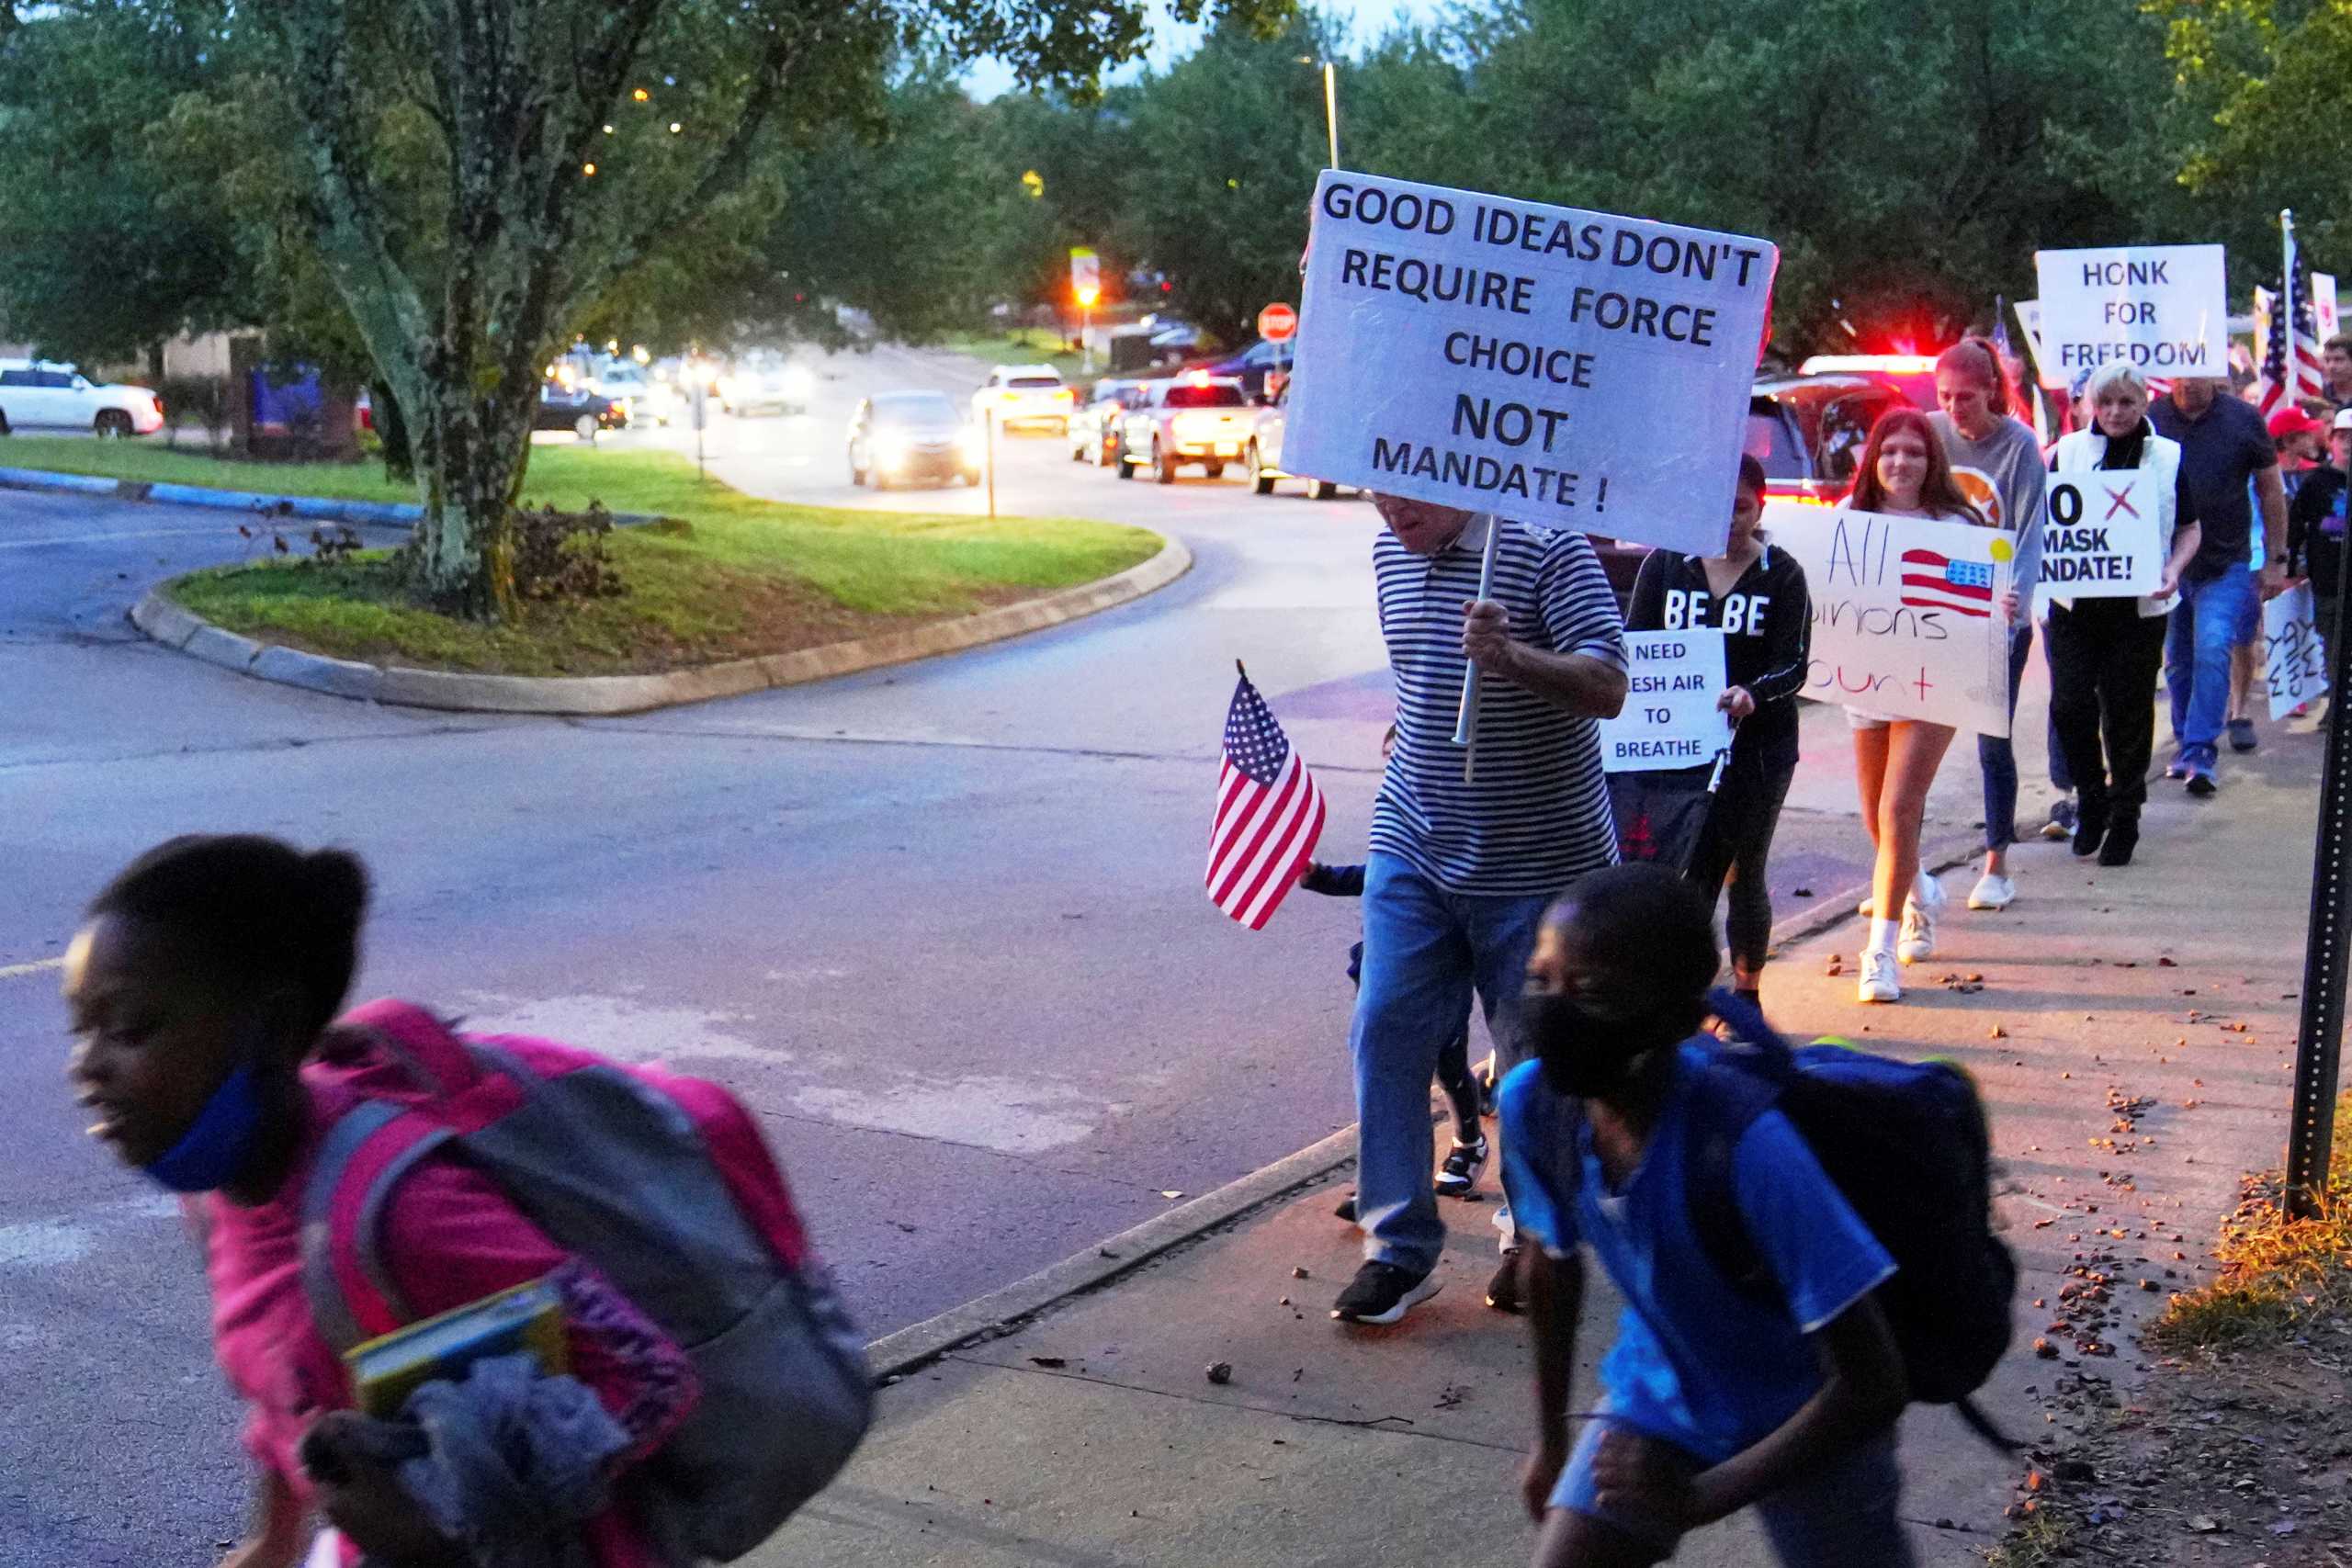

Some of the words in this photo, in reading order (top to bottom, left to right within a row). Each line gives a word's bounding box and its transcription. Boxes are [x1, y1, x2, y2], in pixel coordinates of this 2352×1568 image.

[1323, 183, 1454, 235] GOOD
[1474, 206, 1602, 261] IDEAS
[1612, 229, 1759, 287] DON'T
[2083, 260, 2168, 287] HONK
[1342, 249, 1535, 314] REQUIRE
[1570, 287, 1716, 346] FORCE
[2105, 302, 2156, 323] FOR
[1443, 332, 1596, 389] CHOICE
[2062, 342, 2206, 367] FREEDOM
[1453, 394, 1568, 453] NOT
[2044, 483, 2083, 526] O
[1826, 517, 1889, 586] All
[2043, 528, 2110, 553] MASK
[2037, 556, 2132, 582] NDATE!
[1636, 643, 1686, 660] NEED
[1632, 676, 1666, 693] ESH
[1672, 674, 1704, 691] AIR
[1807, 660, 1933, 701] ount
[1644, 708, 1670, 724] TO
[1615, 739, 1702, 758] BREATHE
